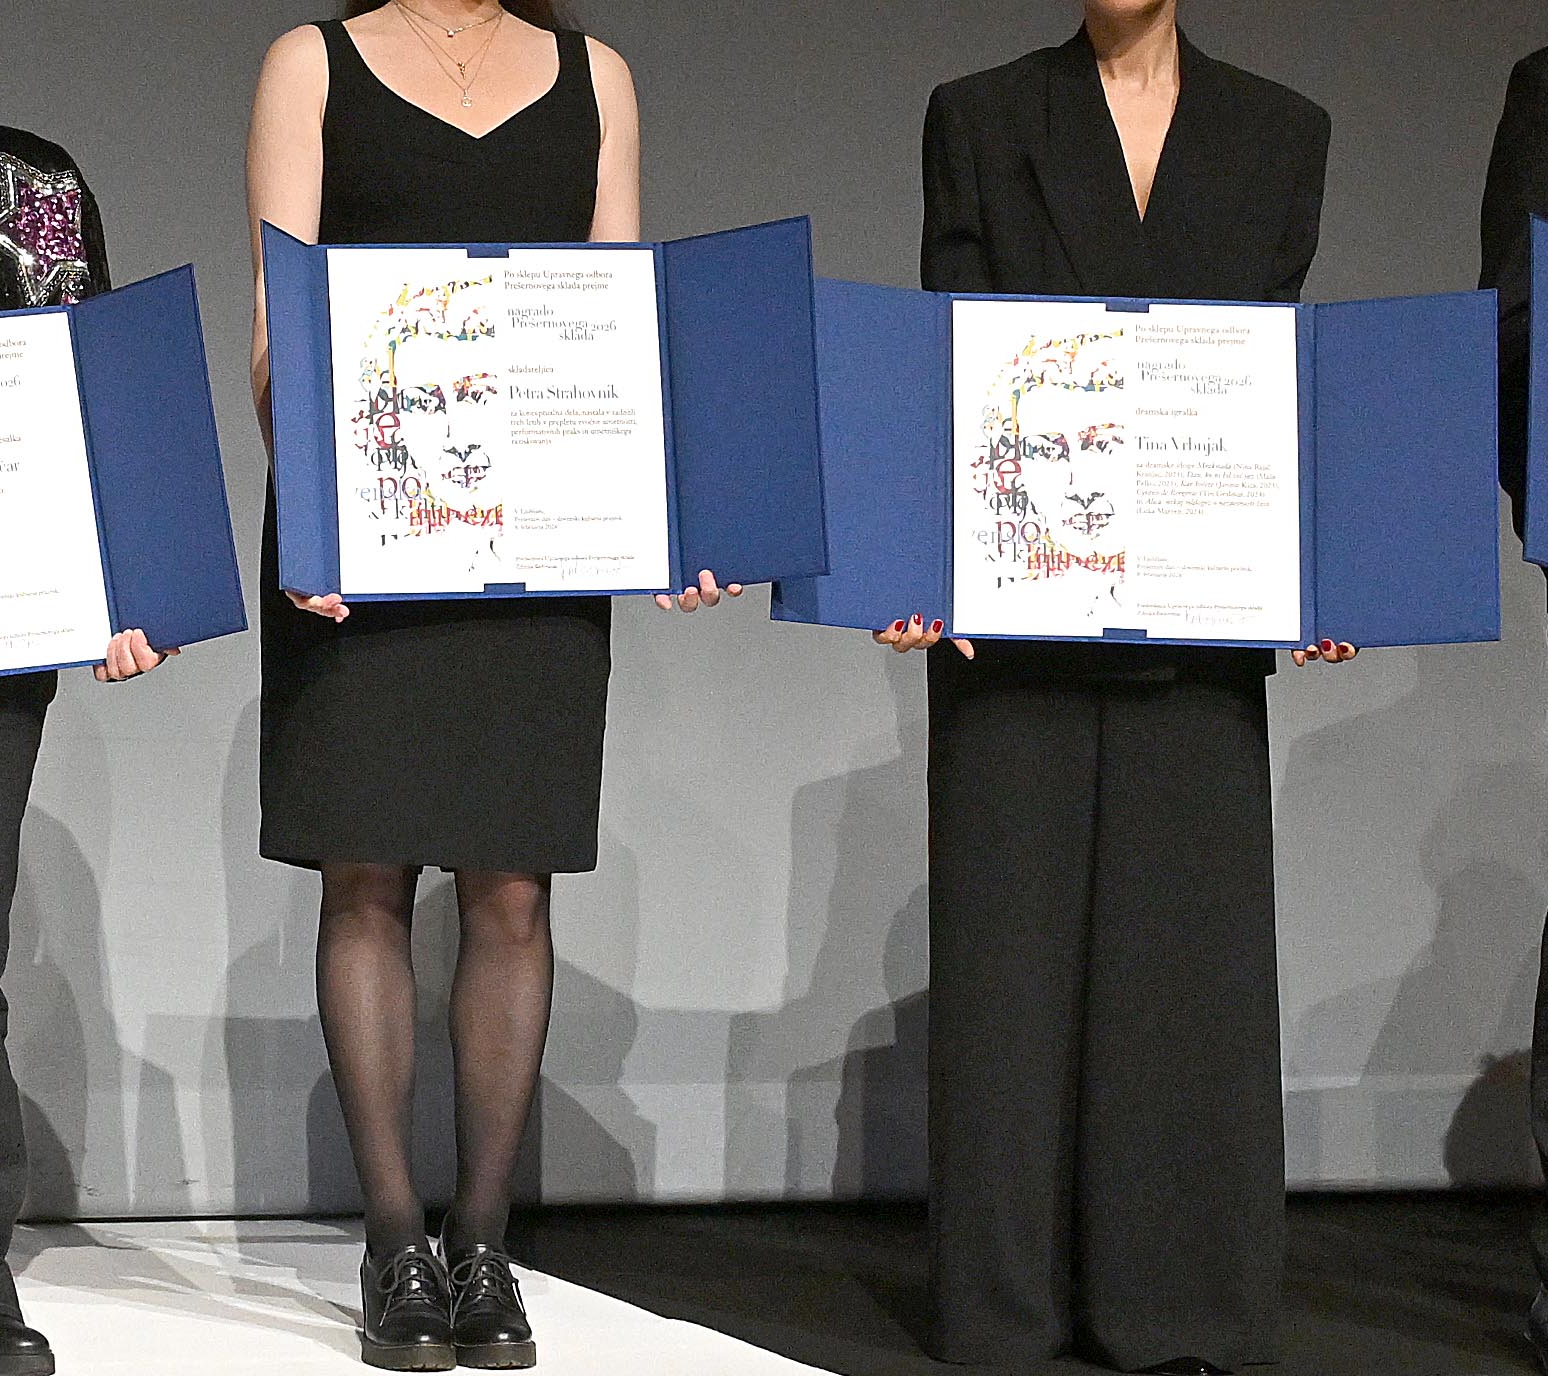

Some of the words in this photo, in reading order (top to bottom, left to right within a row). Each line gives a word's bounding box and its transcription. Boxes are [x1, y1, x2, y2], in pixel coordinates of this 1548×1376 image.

[510, 386, 543, 399] Petra
[547, 385, 619, 399] Strahovnik
[1134, 436, 1166, 450] Tina
